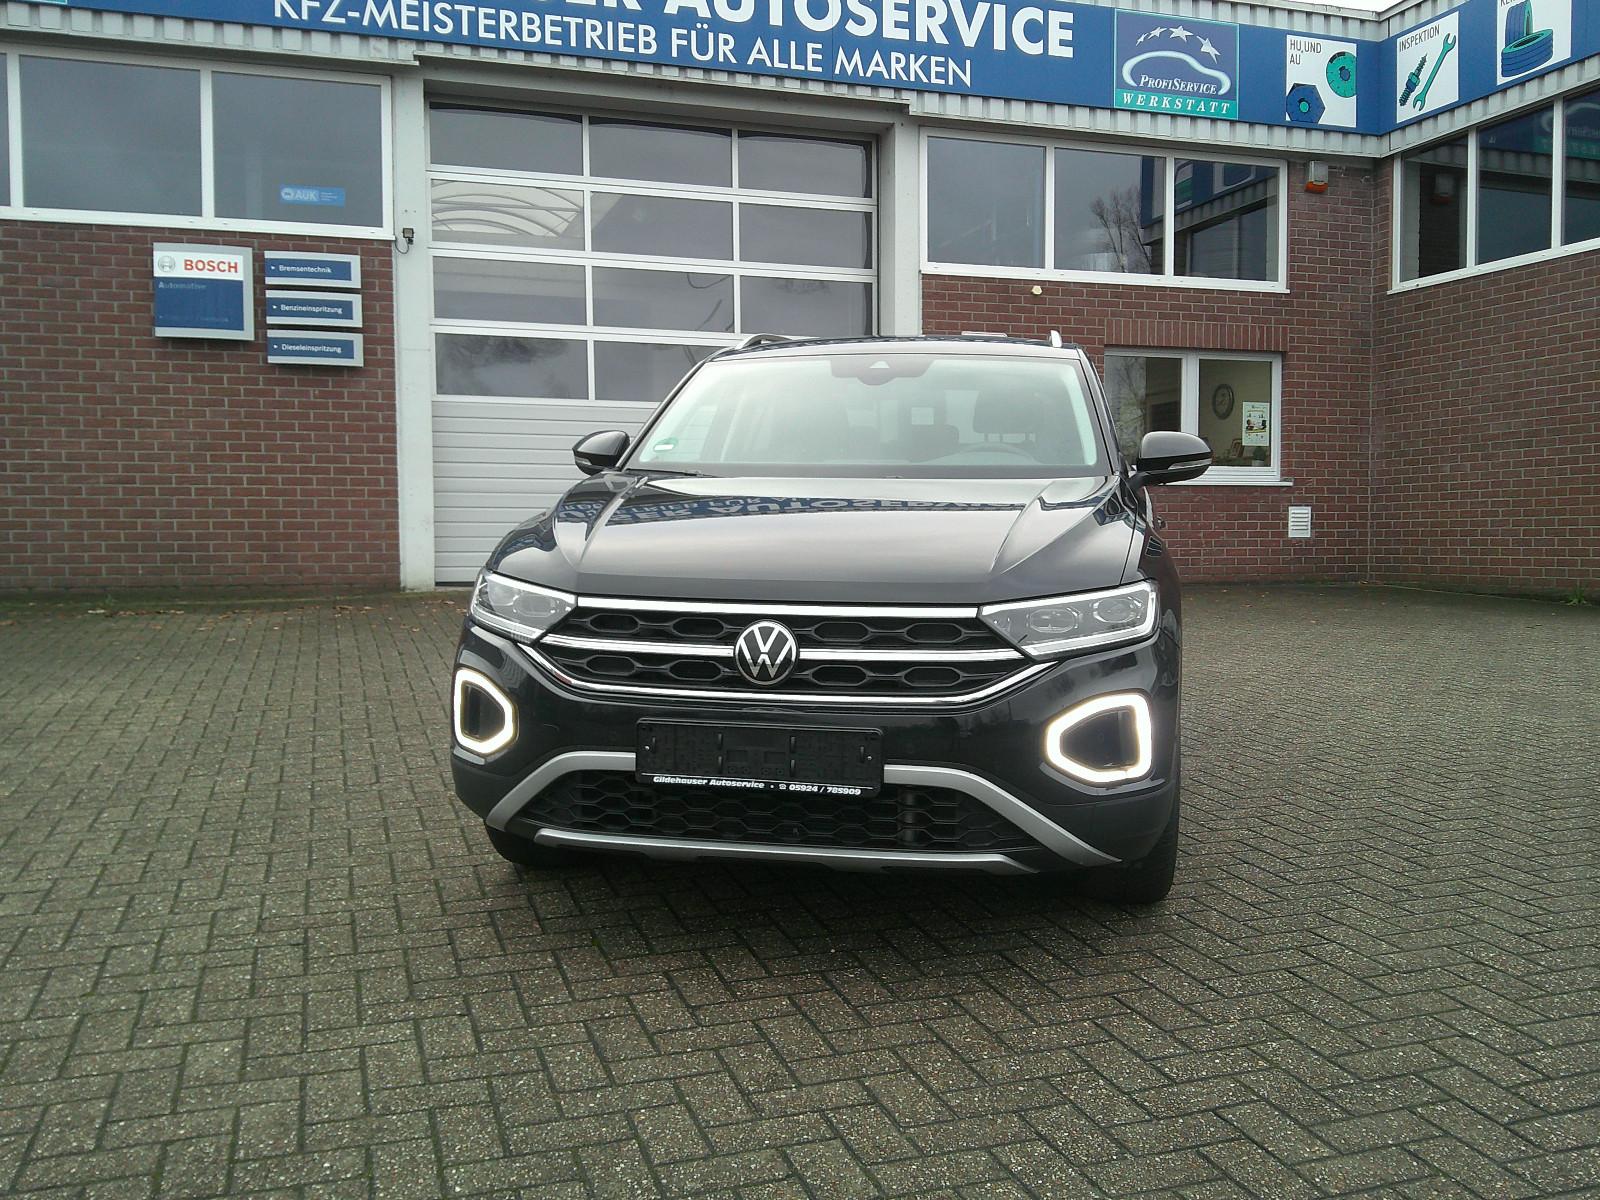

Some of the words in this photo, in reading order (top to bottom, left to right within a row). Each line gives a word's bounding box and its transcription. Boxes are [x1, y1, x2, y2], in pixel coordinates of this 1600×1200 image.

[274, 0, 658, 55] KFZ-MEISTERBETRIEB
[671, 23, 738, 64] FÜR
[746, 37, 823, 72] ALLE
[834, 46, 972, 88] MARKEN
[1399, 23, 1440, 53] INSPEKTION
[1304, 40, 1322, 54] UND
[1289, 53, 1301, 65] AU
[1123, 93, 1231, 115] WERKSTATT
[184, 259, 239, 274] BOSCH
[279, 264, 332, 274] Bremsentechnik
[280, 304, 343, 315] Benzineinspritzung
[281, 343, 342, 354] Dieseleinspritzung
[652, 776, 708, 786] Gildehauser
[709, 778, 766, 789] Autoservice
[789, 784, 818, 793] 05924
[826, 786, 862, 796] 785909
